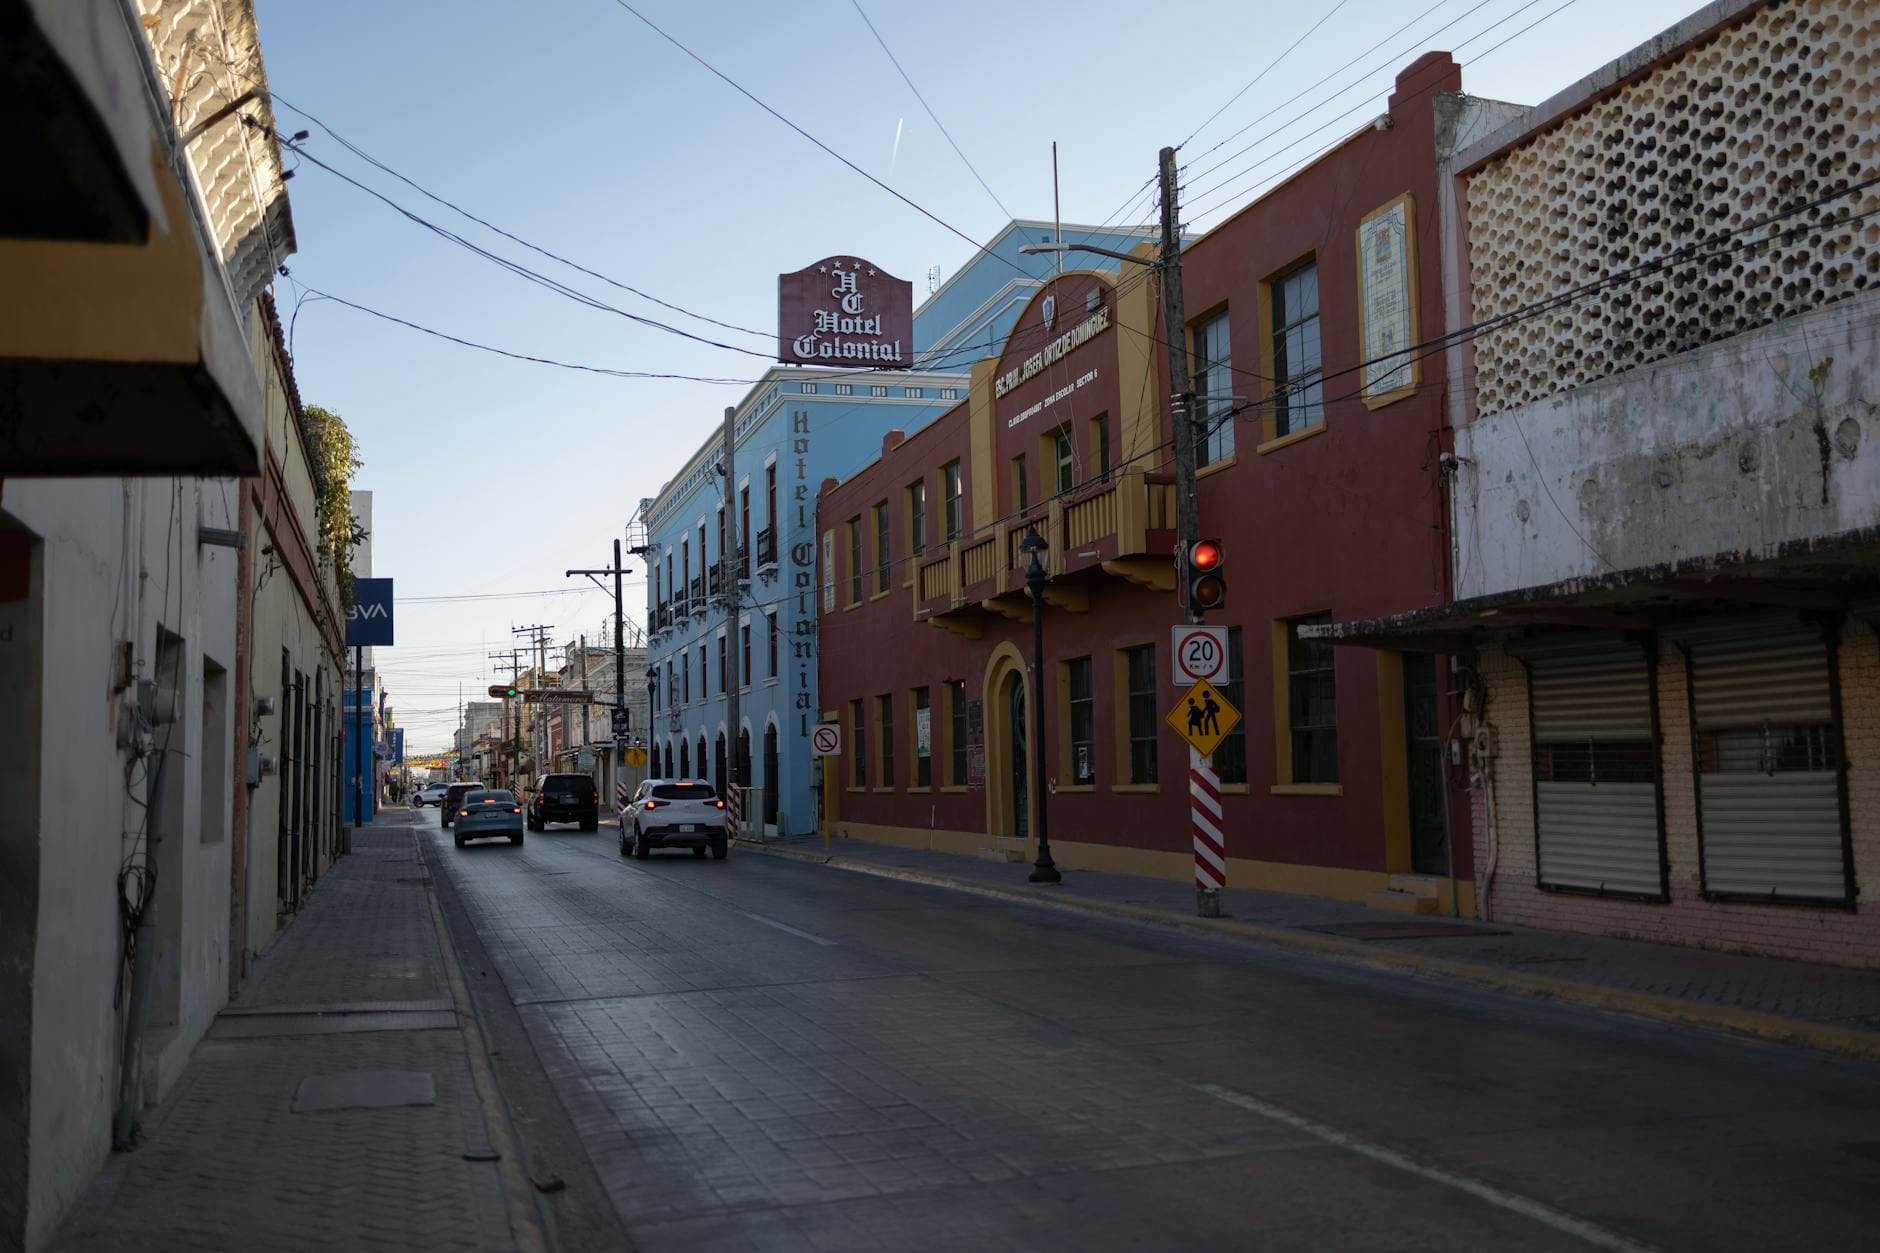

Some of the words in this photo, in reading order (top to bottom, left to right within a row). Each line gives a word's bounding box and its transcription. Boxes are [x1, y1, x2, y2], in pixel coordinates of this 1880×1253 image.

[813, 309, 883, 338] Hotel
[792, 334, 903, 362] Colonial
[1022, 350, 1043, 381] JOSEFA
[1044, 338, 1063, 367] ORTIZ
[1062, 331, 1071, 356] DE
[1055, 382, 1075, 402] ESCOLAR
[1076, 371, 1093, 389] SECTOR
[792, 411, 810, 529] Hotel
[792, 542, 814, 737] Colonial
[1190, 640, 1213, 661] 20
